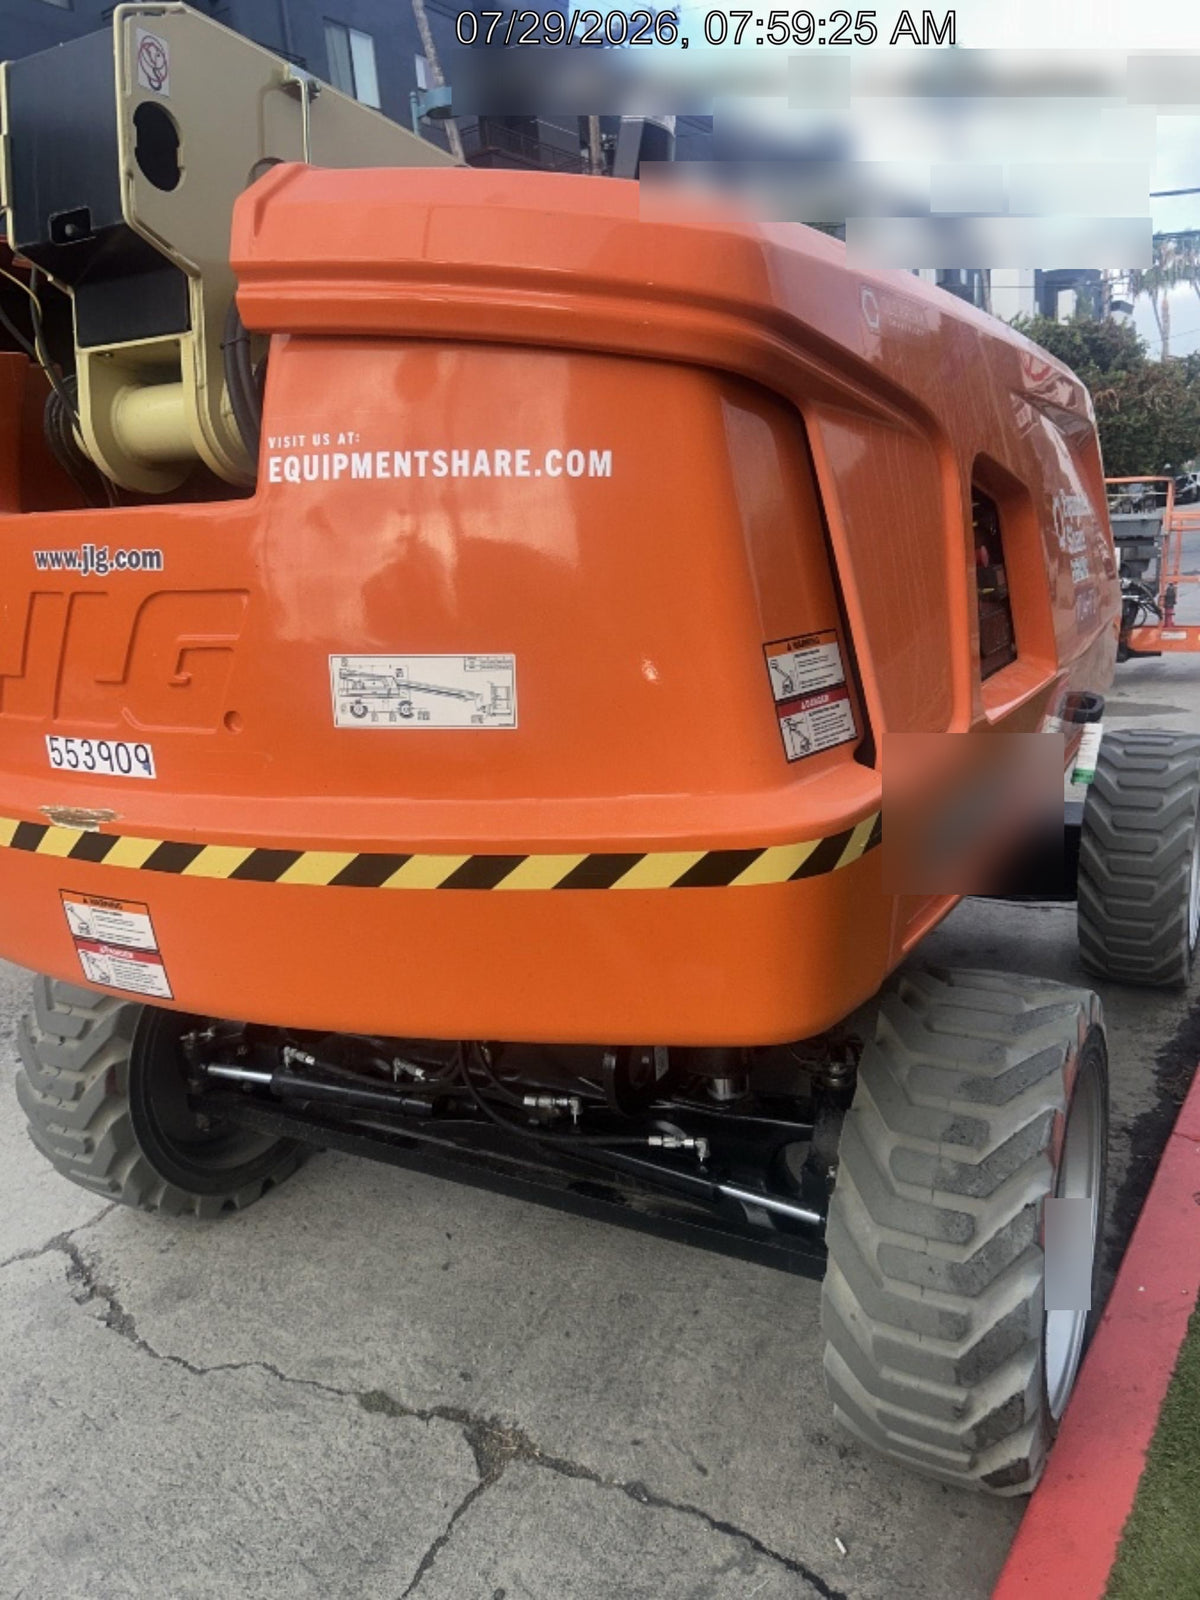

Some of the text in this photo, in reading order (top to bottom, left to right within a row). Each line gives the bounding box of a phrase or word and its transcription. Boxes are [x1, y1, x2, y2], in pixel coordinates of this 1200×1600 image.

[268, 431, 360, 449] VISIT US AT:
[268, 449, 613, 484] EQUIPMENTSHARE.COM
[34, 544, 164, 576] www.jlg.com
[49, 736, 152, 776] 553909
